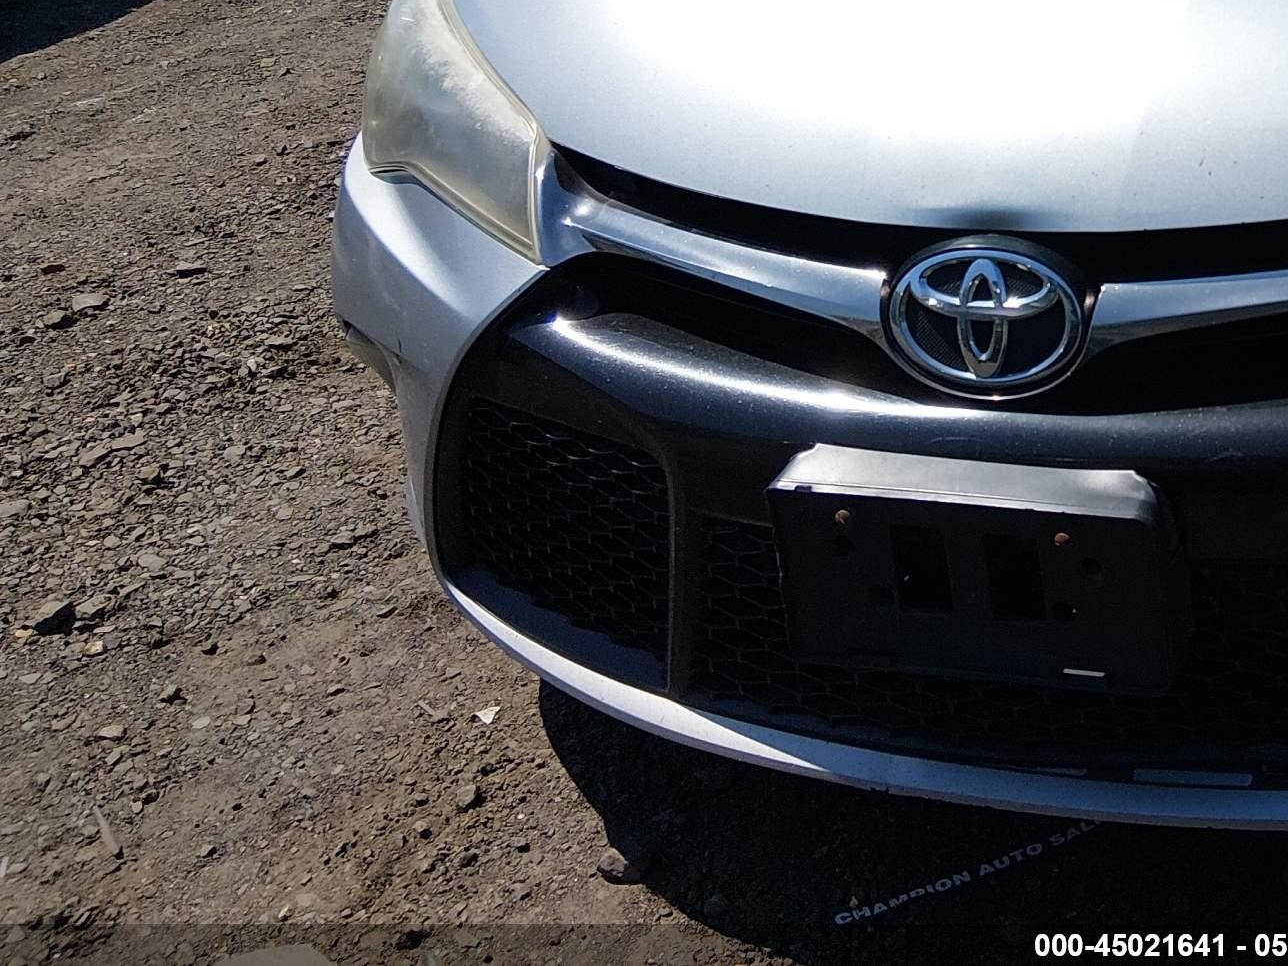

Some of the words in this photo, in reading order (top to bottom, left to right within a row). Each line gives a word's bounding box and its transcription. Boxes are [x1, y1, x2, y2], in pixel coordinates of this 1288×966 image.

[834, 870, 971, 925] CHAMPION
[979, 843, 1043, 876] AUTO
[1049, 820, 1100, 847] SAL
